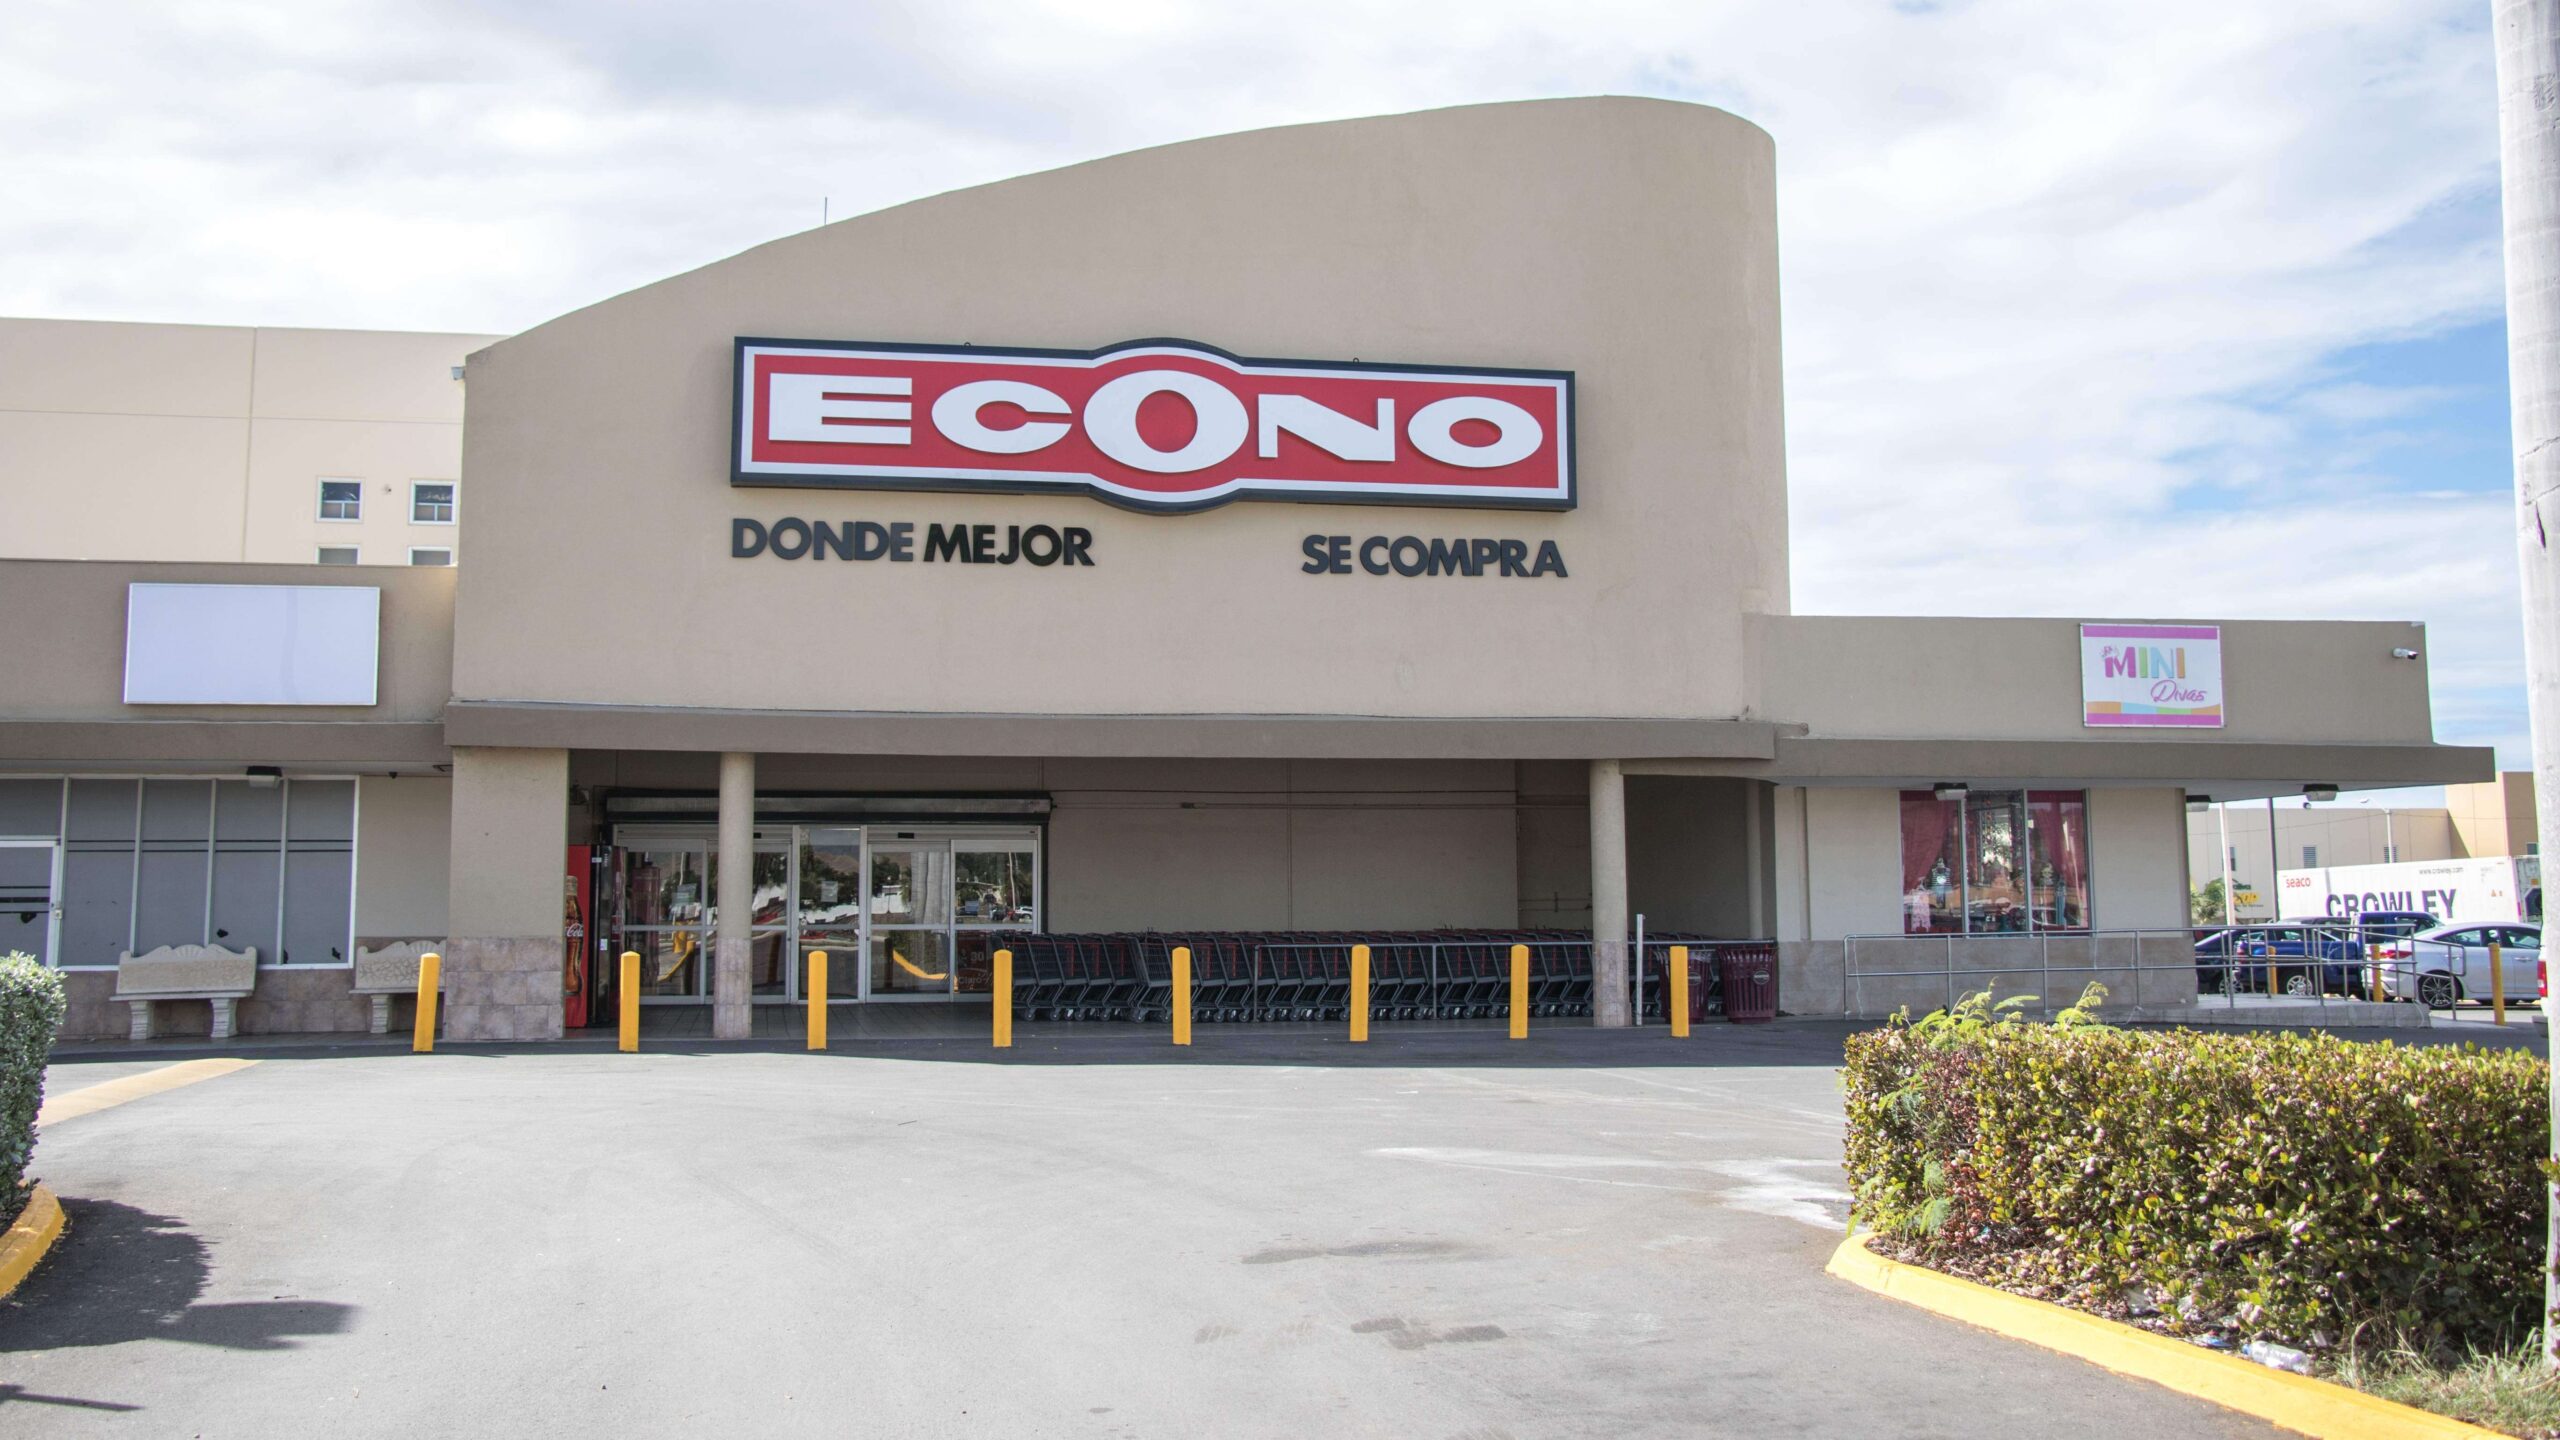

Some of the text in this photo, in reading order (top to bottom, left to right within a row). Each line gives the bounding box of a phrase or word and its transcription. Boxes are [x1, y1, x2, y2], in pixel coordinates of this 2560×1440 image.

[768, 369, 1544, 474] ECONO
[732, 517, 1095, 567] DONDE MEJOR
[1302, 534, 1568, 578] SE COMPRA
[2103, 646, 2186, 679] MINI
[2150, 679, 2208, 702] Divas
[2285, 877, 2312, 889] seaco
[2325, 888, 2458, 919] CROWLEY
